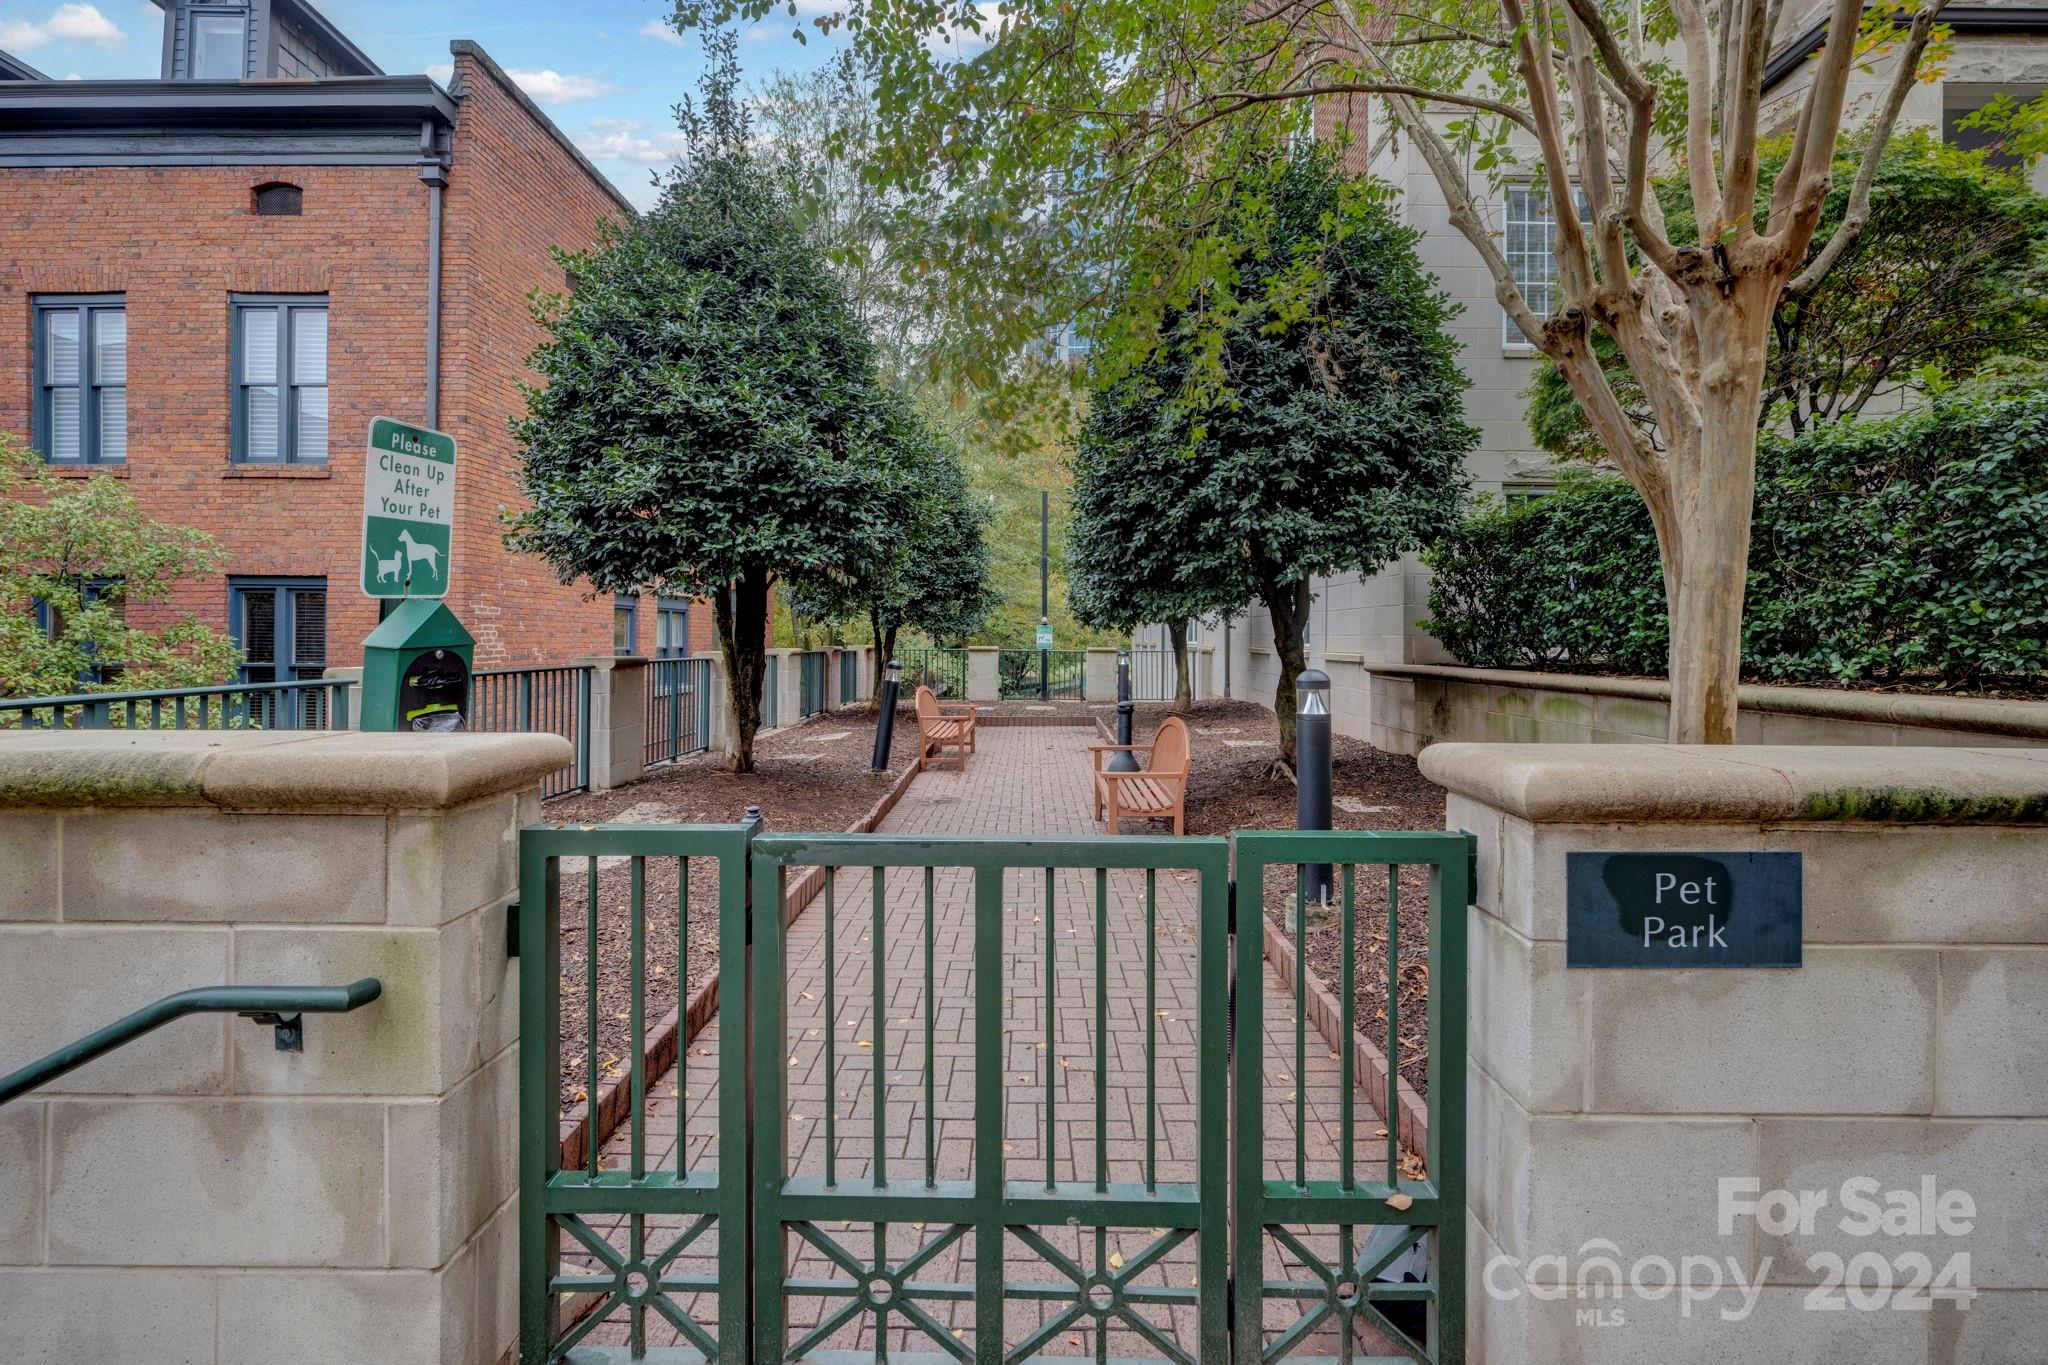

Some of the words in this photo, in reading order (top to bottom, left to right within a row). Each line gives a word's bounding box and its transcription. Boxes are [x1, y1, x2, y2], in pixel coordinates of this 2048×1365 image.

[391, 432, 437, 457] Please
[379, 454, 420, 477] Clean
[427, 464, 444, 485] Up
[394, 478, 430, 498] After
[381, 496, 413, 515] Your
[420, 503, 441, 519] Pet
[1655, 872, 1717, 905] Pet
[1643, 913, 1728, 948] Park
